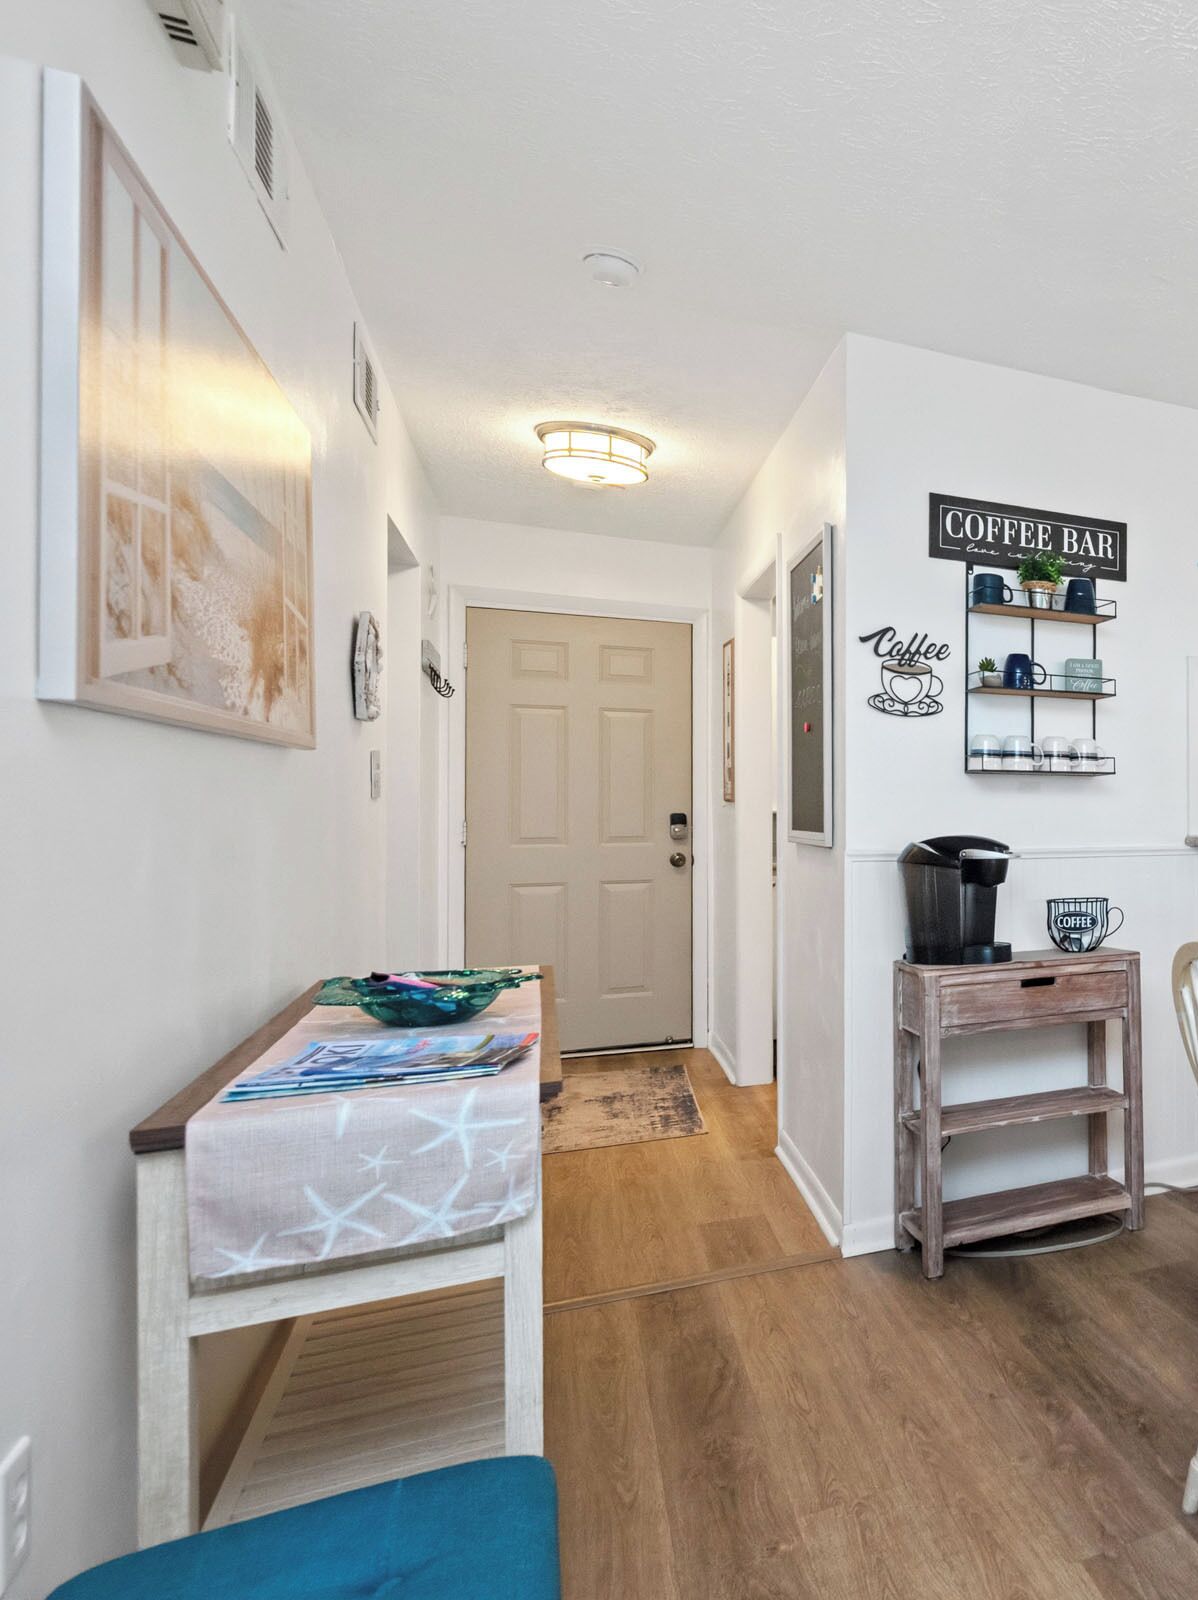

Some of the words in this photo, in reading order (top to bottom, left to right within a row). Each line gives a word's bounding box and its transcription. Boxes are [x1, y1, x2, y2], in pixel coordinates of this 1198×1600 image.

[945, 510, 1052, 550] COFFEE
[1062, 527, 1115, 559] BAR
[859, 626, 951, 668] Coffee
[1057, 916, 1093, 928] COFFEE
